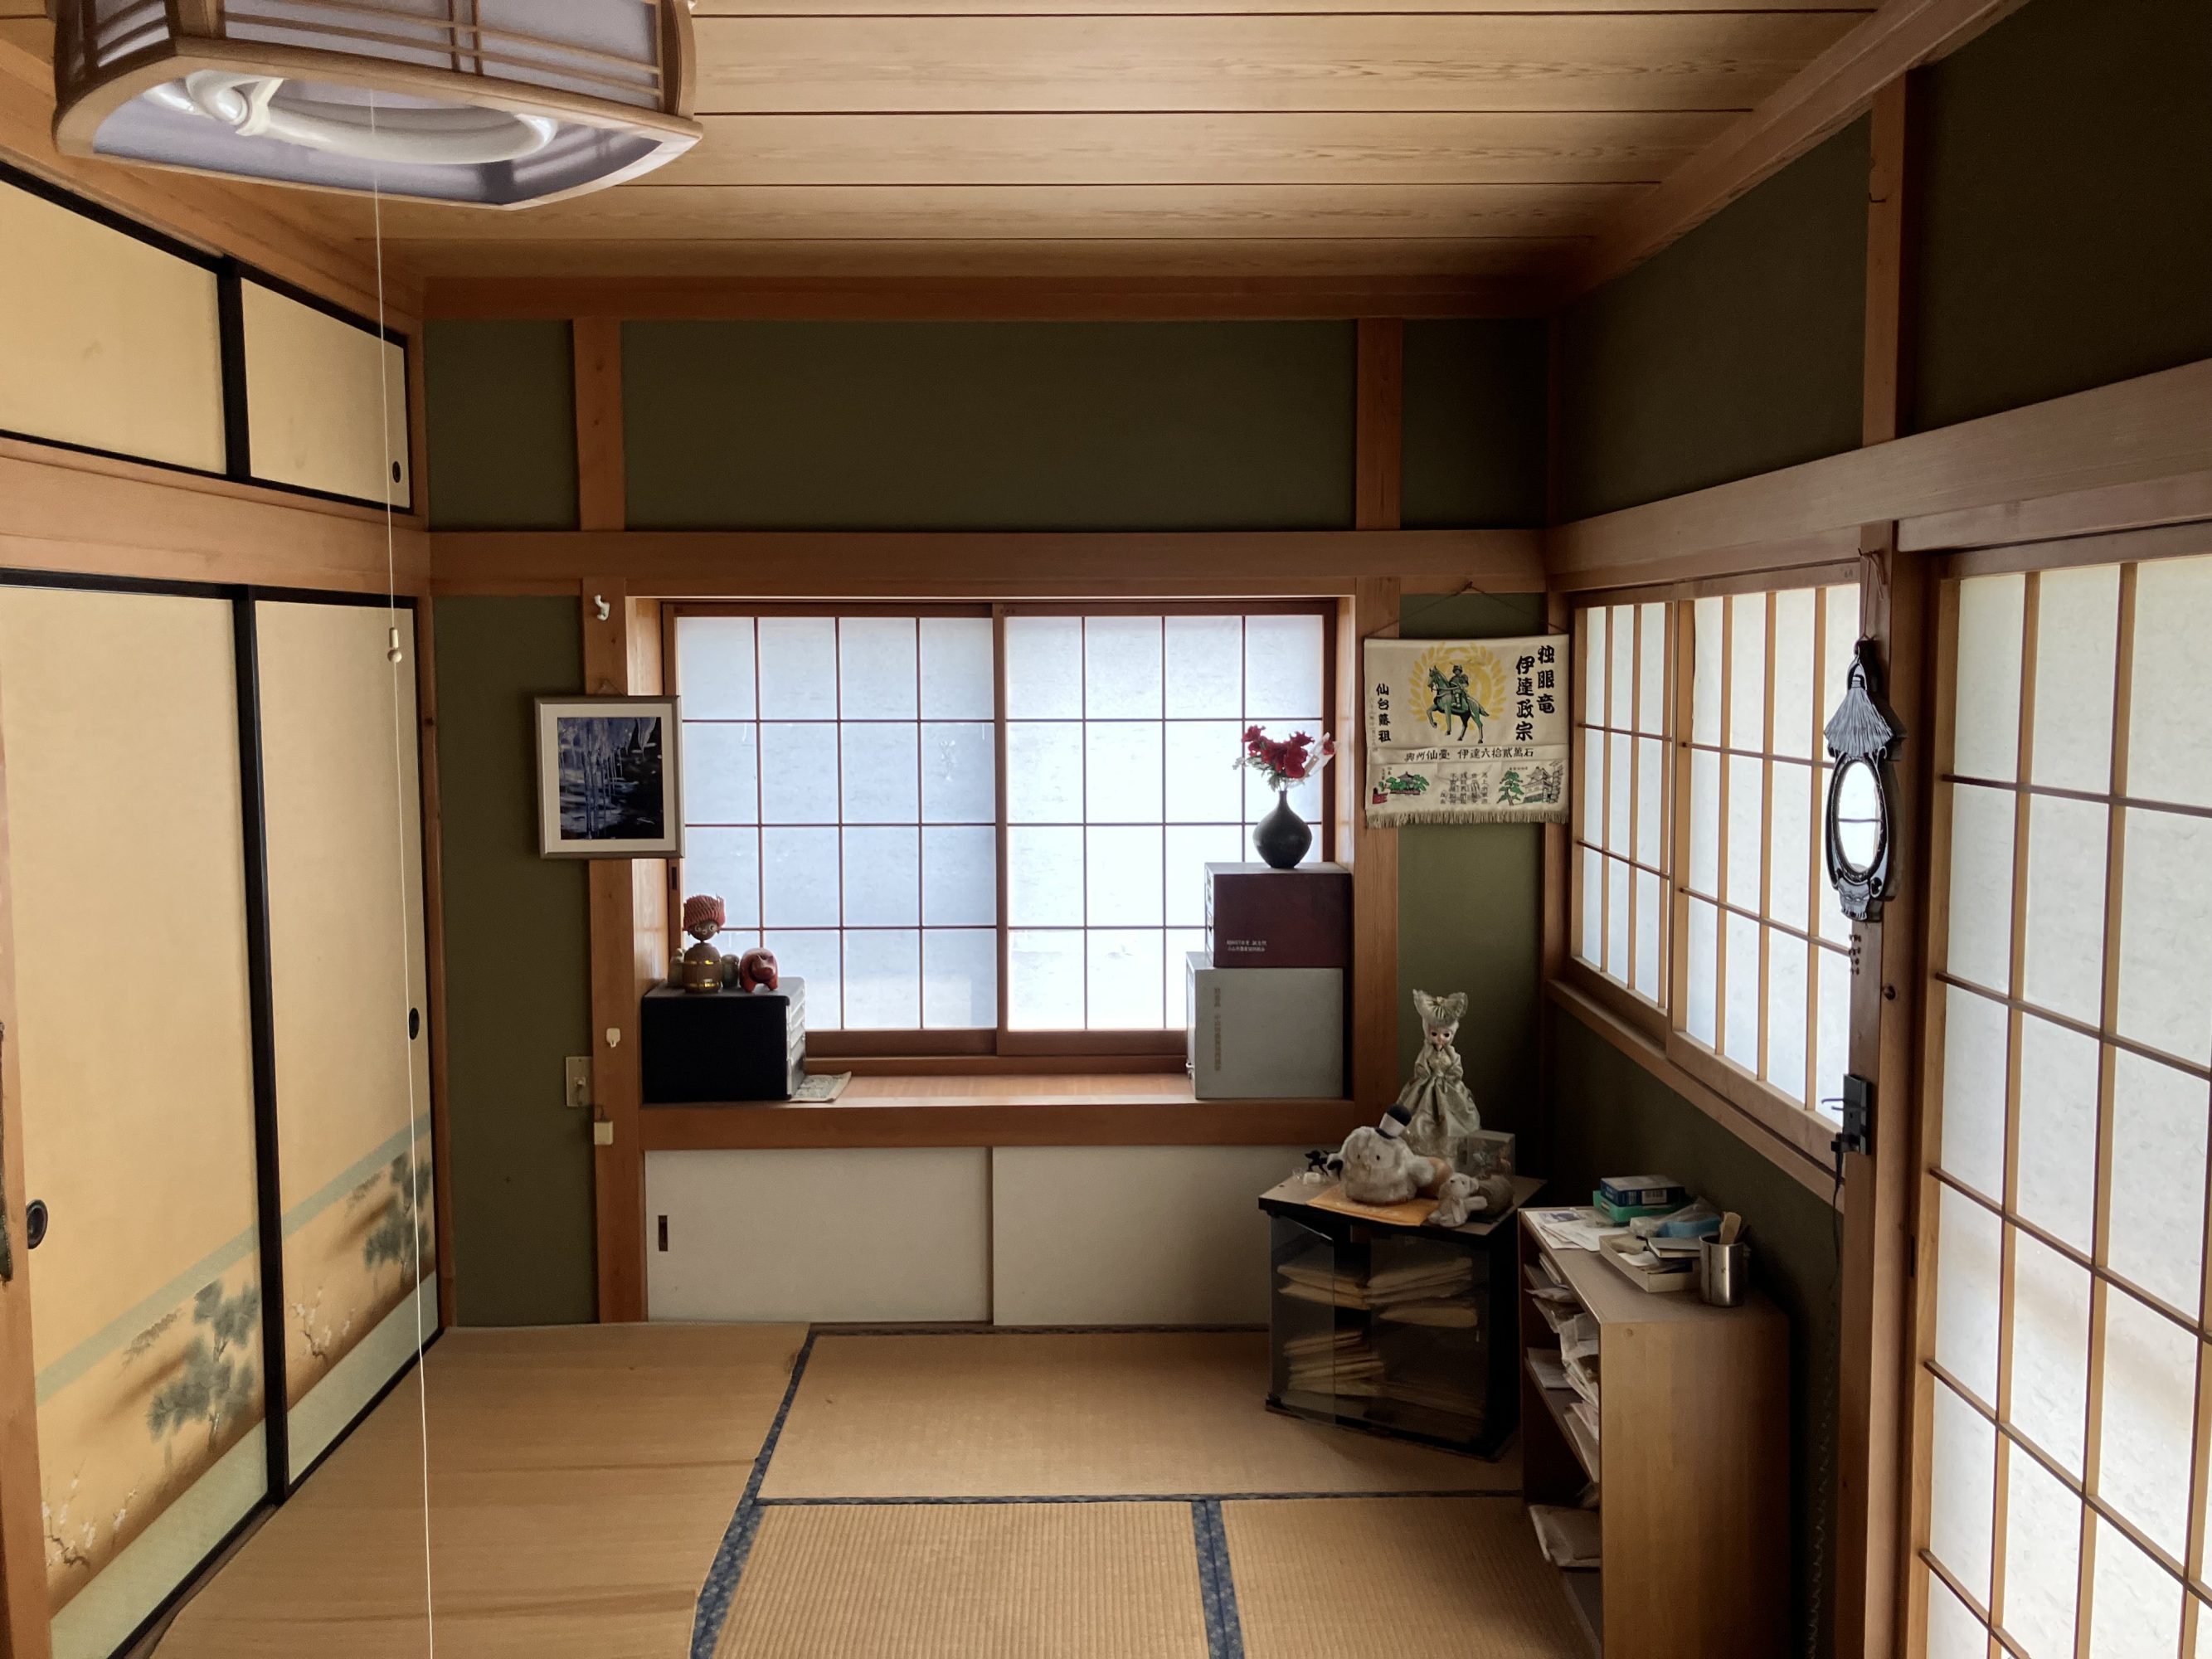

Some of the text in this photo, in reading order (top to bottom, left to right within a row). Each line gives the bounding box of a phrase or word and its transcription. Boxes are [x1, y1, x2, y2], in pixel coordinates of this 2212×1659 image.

[1515, 655, 1535, 742] 伊達政宗
[1536, 645, 1555, 714] 独眼竜
